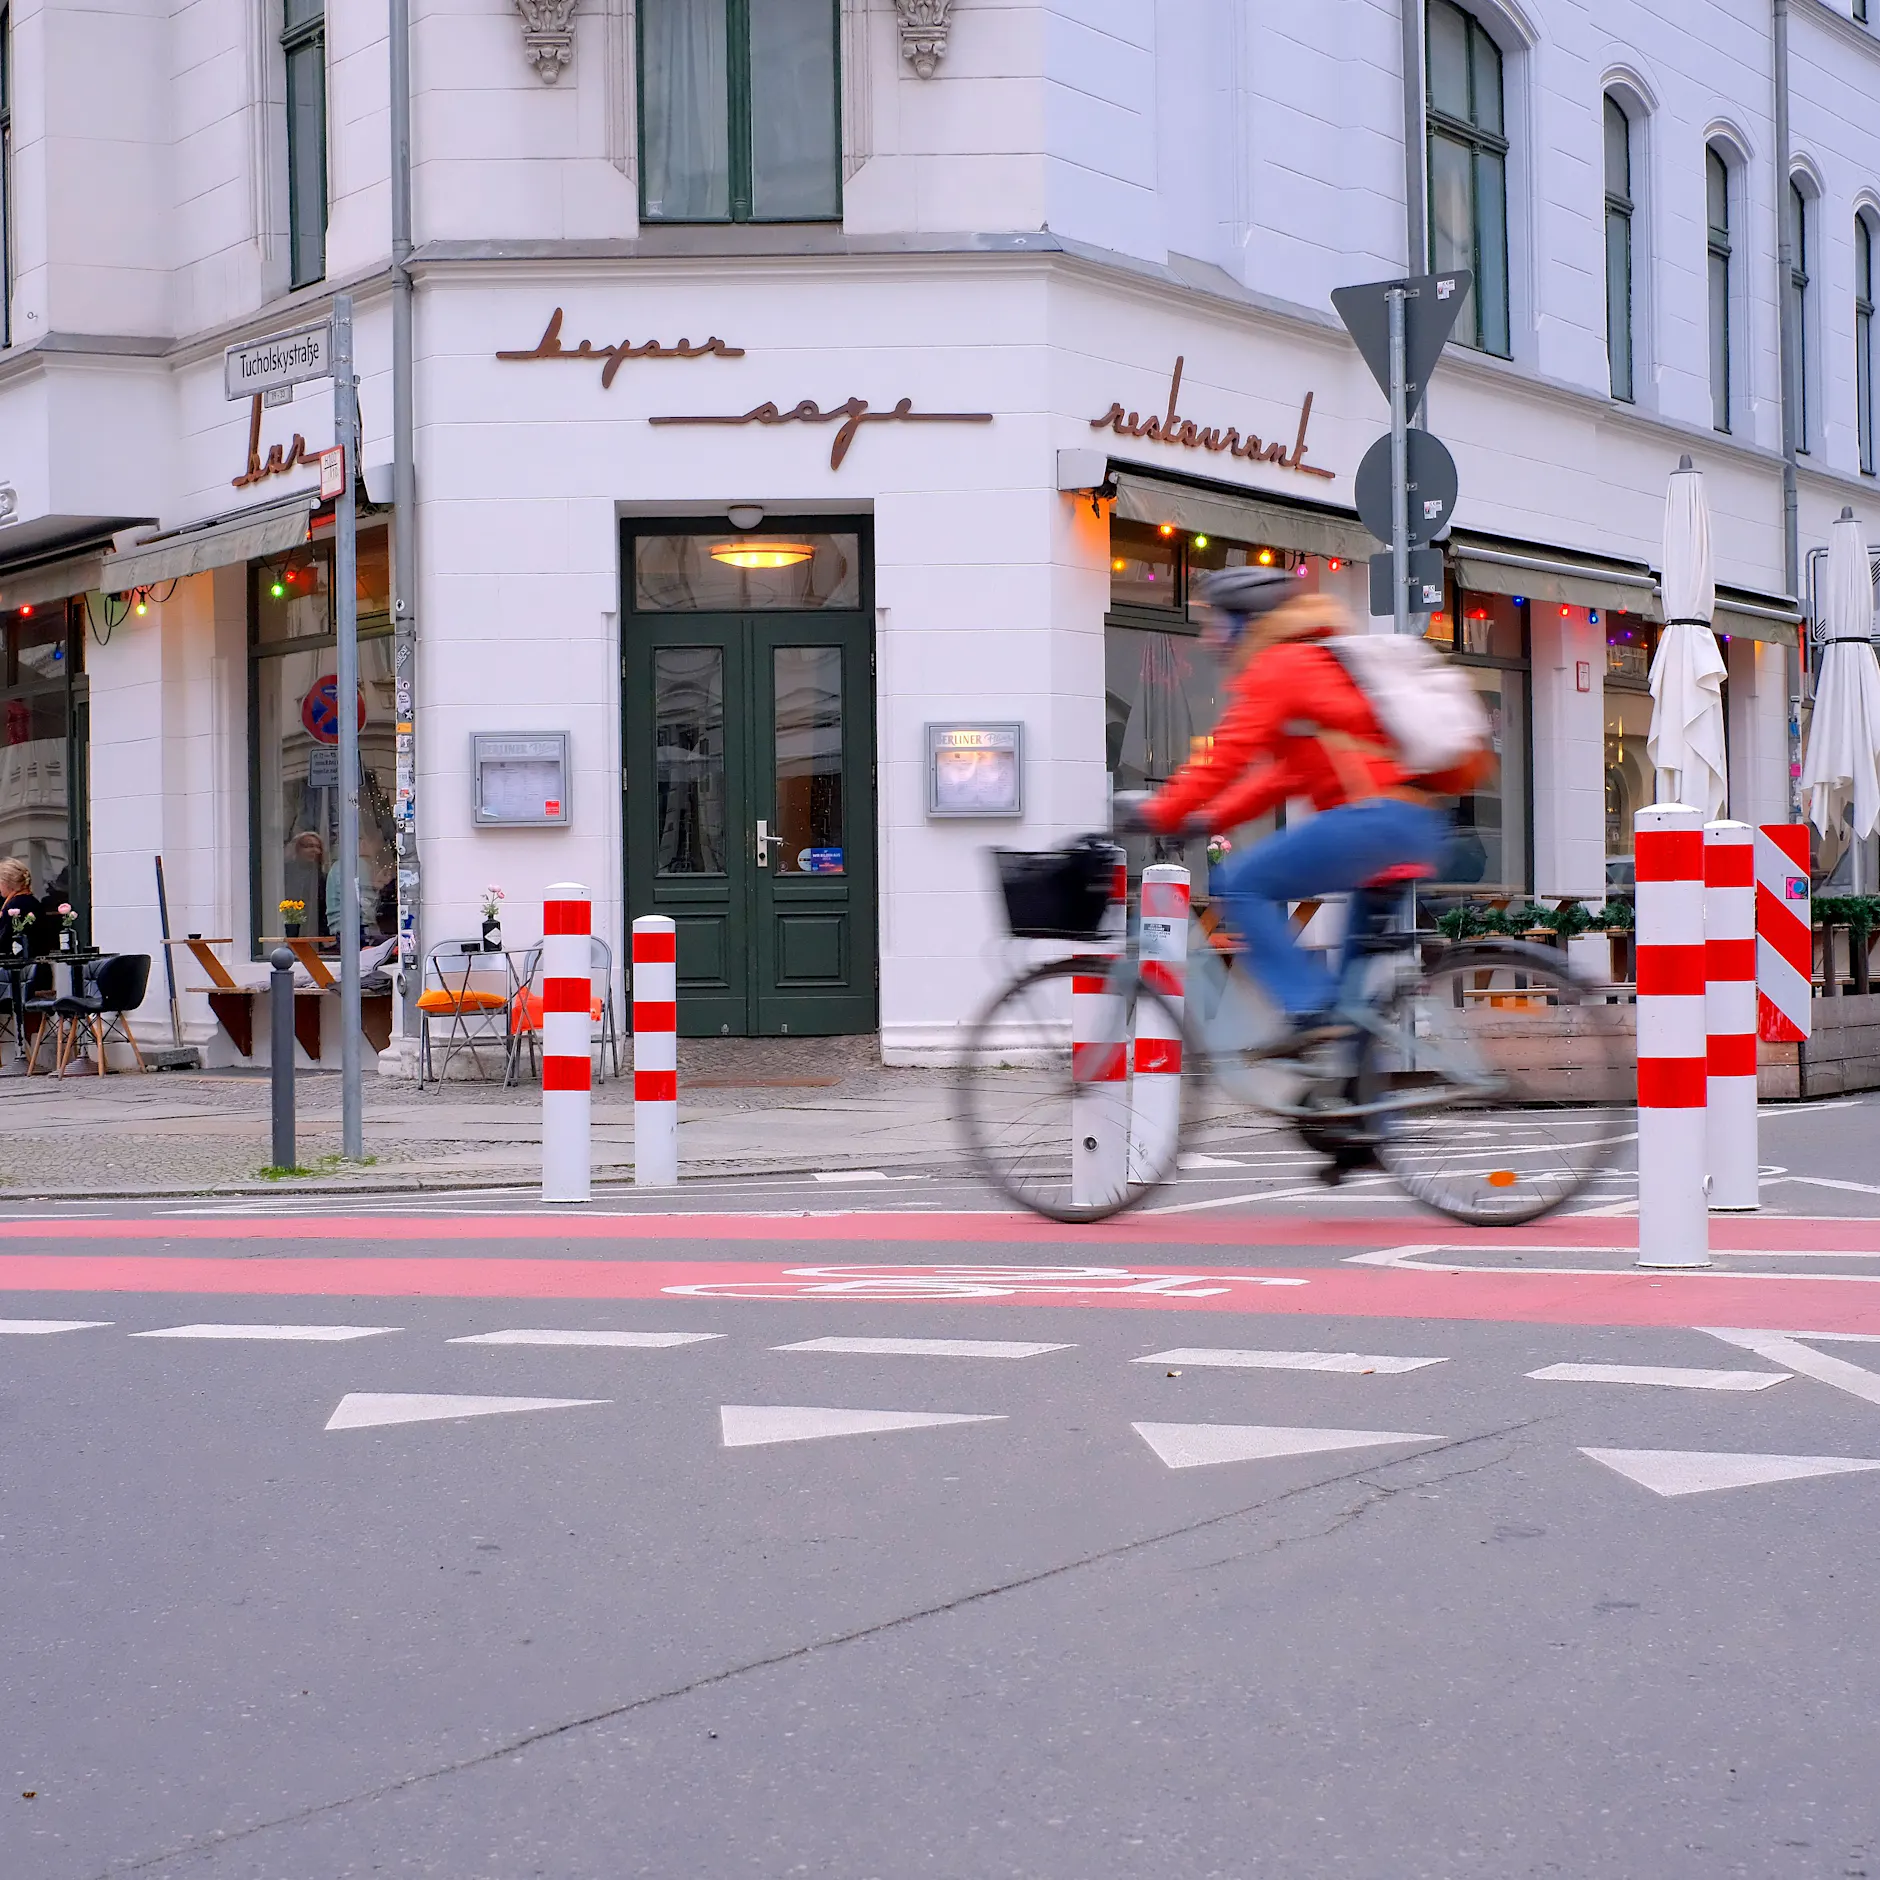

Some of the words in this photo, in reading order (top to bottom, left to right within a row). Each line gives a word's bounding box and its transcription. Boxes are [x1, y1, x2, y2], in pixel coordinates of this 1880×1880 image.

[240, 336, 320, 378] Tucholskystraße
[496, 307, 745, 389] keyser
[232, 394, 321, 487] bar
[648, 396, 994, 471] soze
[1091, 355, 1335, 480] restaurant
[937, 735, 982, 747] BERLINER
